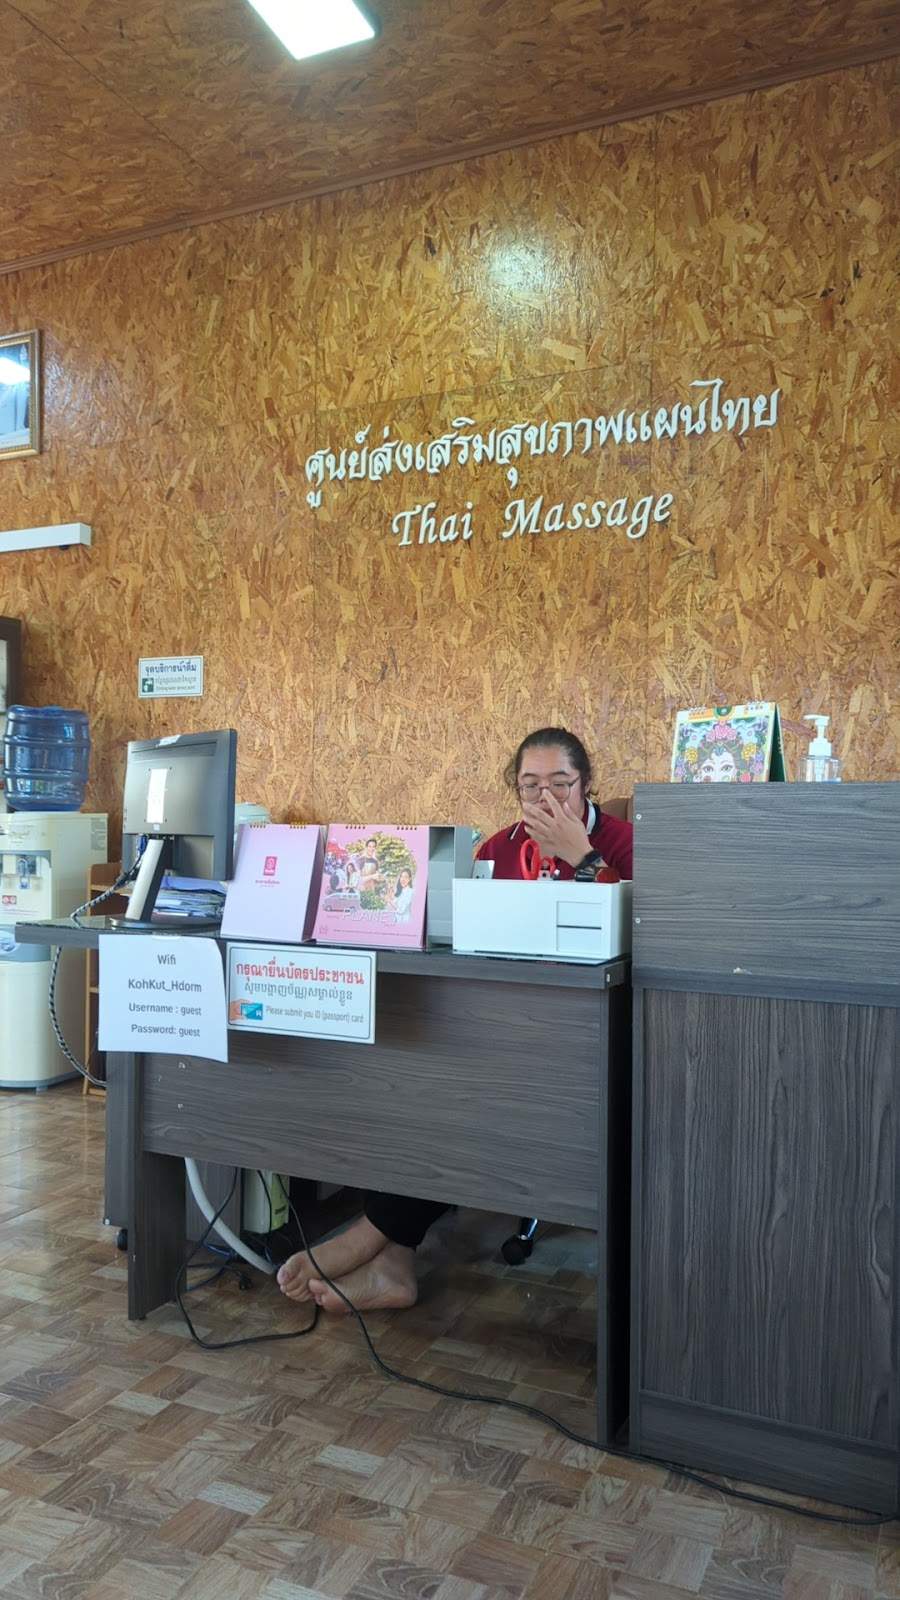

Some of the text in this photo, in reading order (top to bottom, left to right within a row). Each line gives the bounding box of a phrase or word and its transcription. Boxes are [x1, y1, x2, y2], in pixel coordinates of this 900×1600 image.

[305, 378, 781, 509] ศูนย์ส่งเสริมสุขภาพแผนไทย
[391, 493, 674, 546] Thai Massage
[157, 953, 177, 965] Wifi
[235, 956, 365, 985] กรุณายื่นบัตรประชาชน
[128, 978, 202, 993] KohKut_Hdorm
[128, 1002, 174, 1014] Username
[180, 1005, 202, 1016] guest
[131, 1023, 201, 1037] Password: guest
